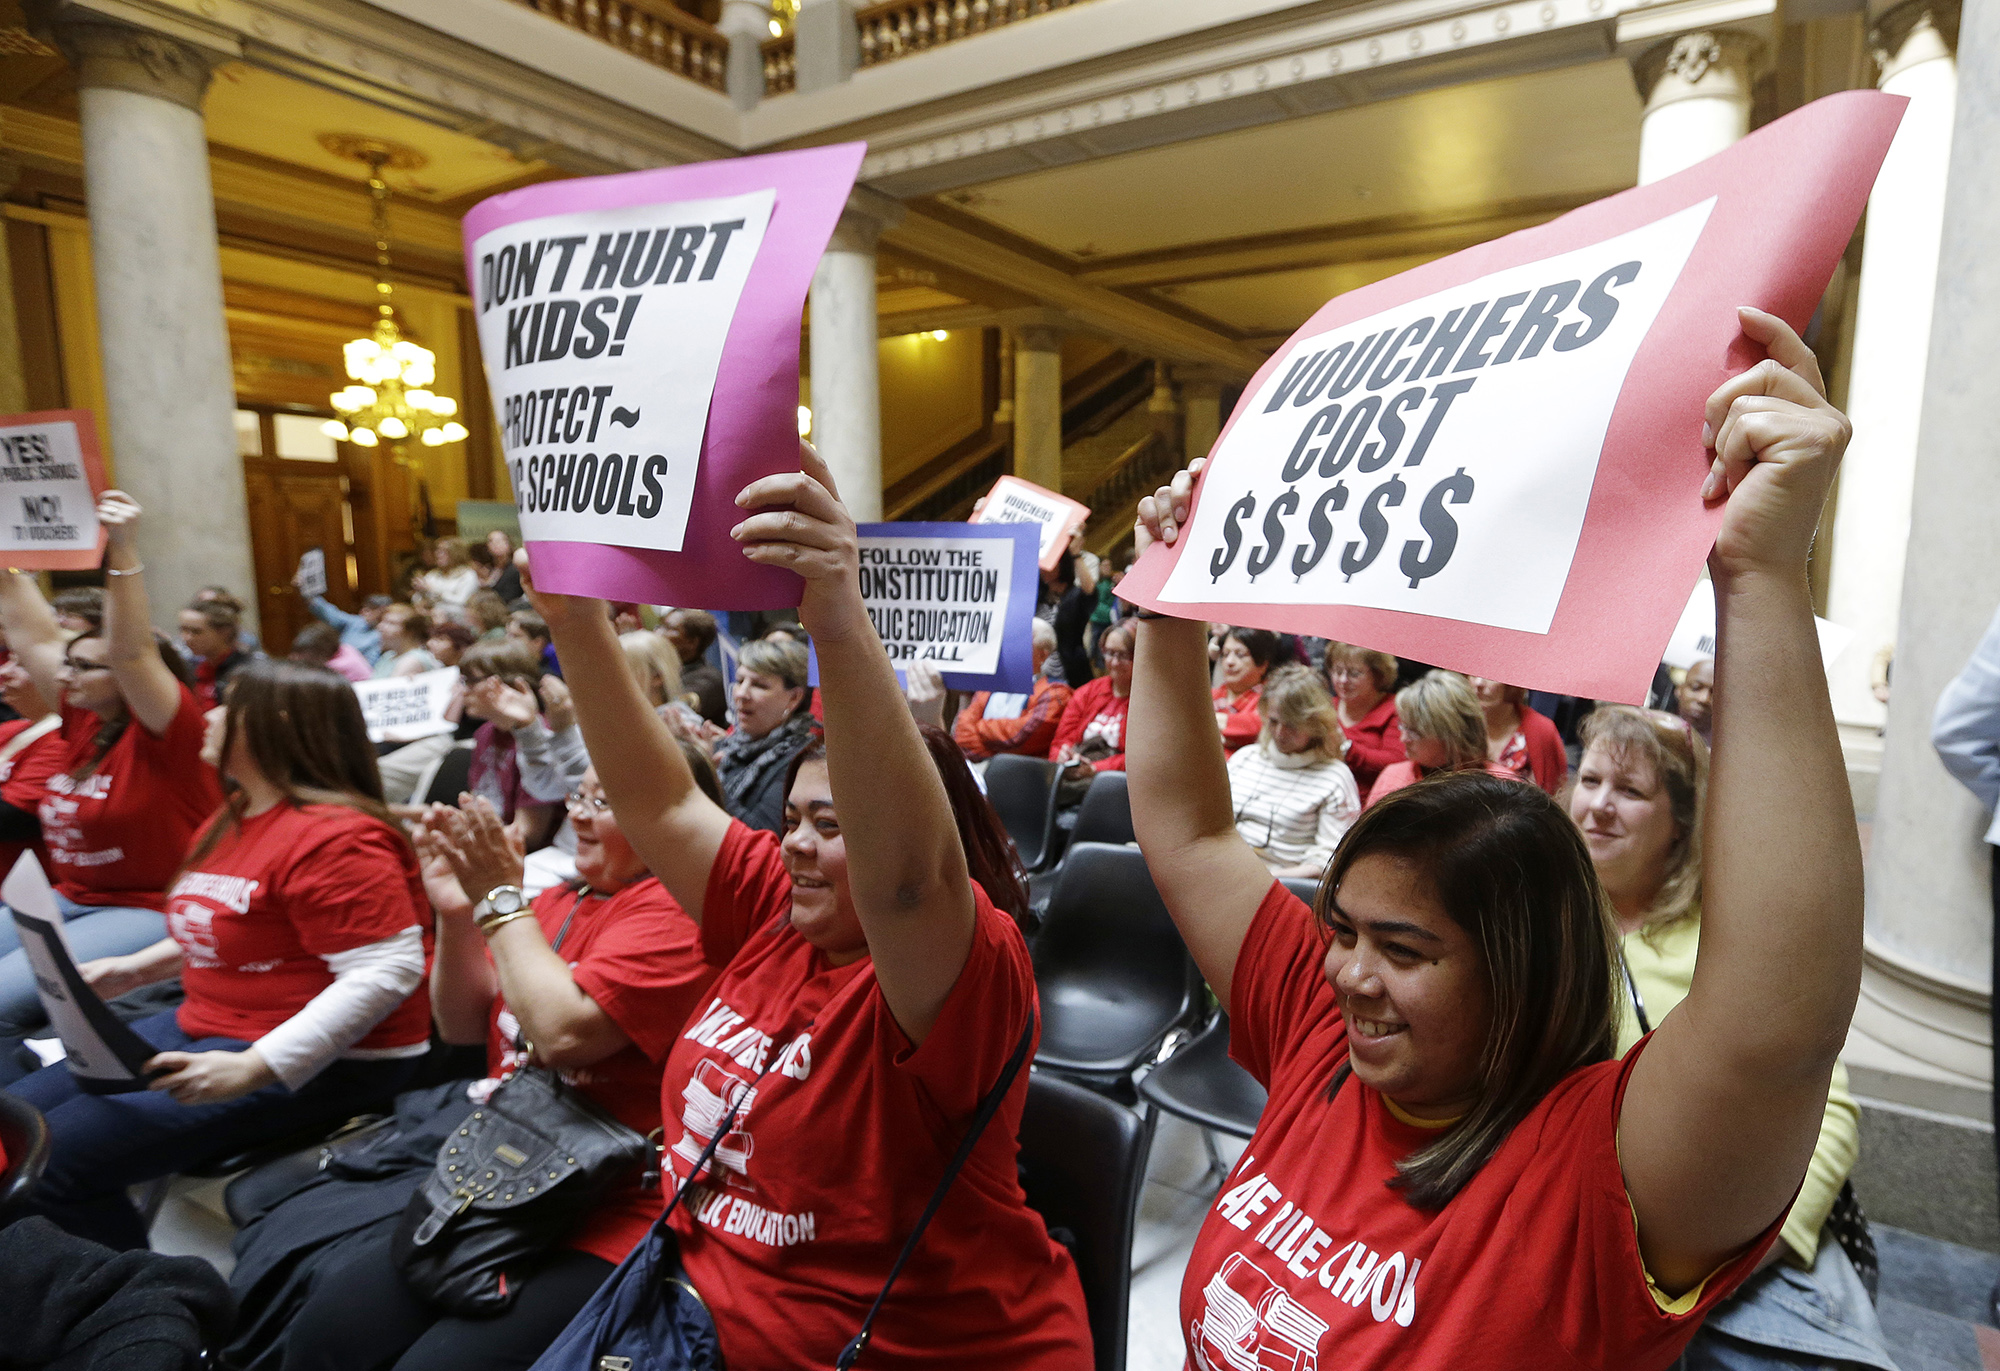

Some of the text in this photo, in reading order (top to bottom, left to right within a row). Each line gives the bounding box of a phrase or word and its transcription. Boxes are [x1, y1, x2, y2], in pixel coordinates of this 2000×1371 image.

[482, 218, 746, 315] DON'T HURT
[504, 294, 643, 370] KIDS!
[1262, 259, 1642, 414] VOUCHERS
[1281, 376, 1478, 483] COST
[527, 452, 668, 519] SCHOOLS
[1004, 494, 1054, 522] VOUCHERS
[1209, 466, 1475, 589] $$$$$
[858, 548, 983, 567] FOLLOW THE
[858, 566, 998, 603] ONSTITUTION
[867, 607, 993, 643] BLIC EDUCATION
[884, 643, 964, 662] OR ALL
[723, 1197, 816, 1247] EDUCATION
